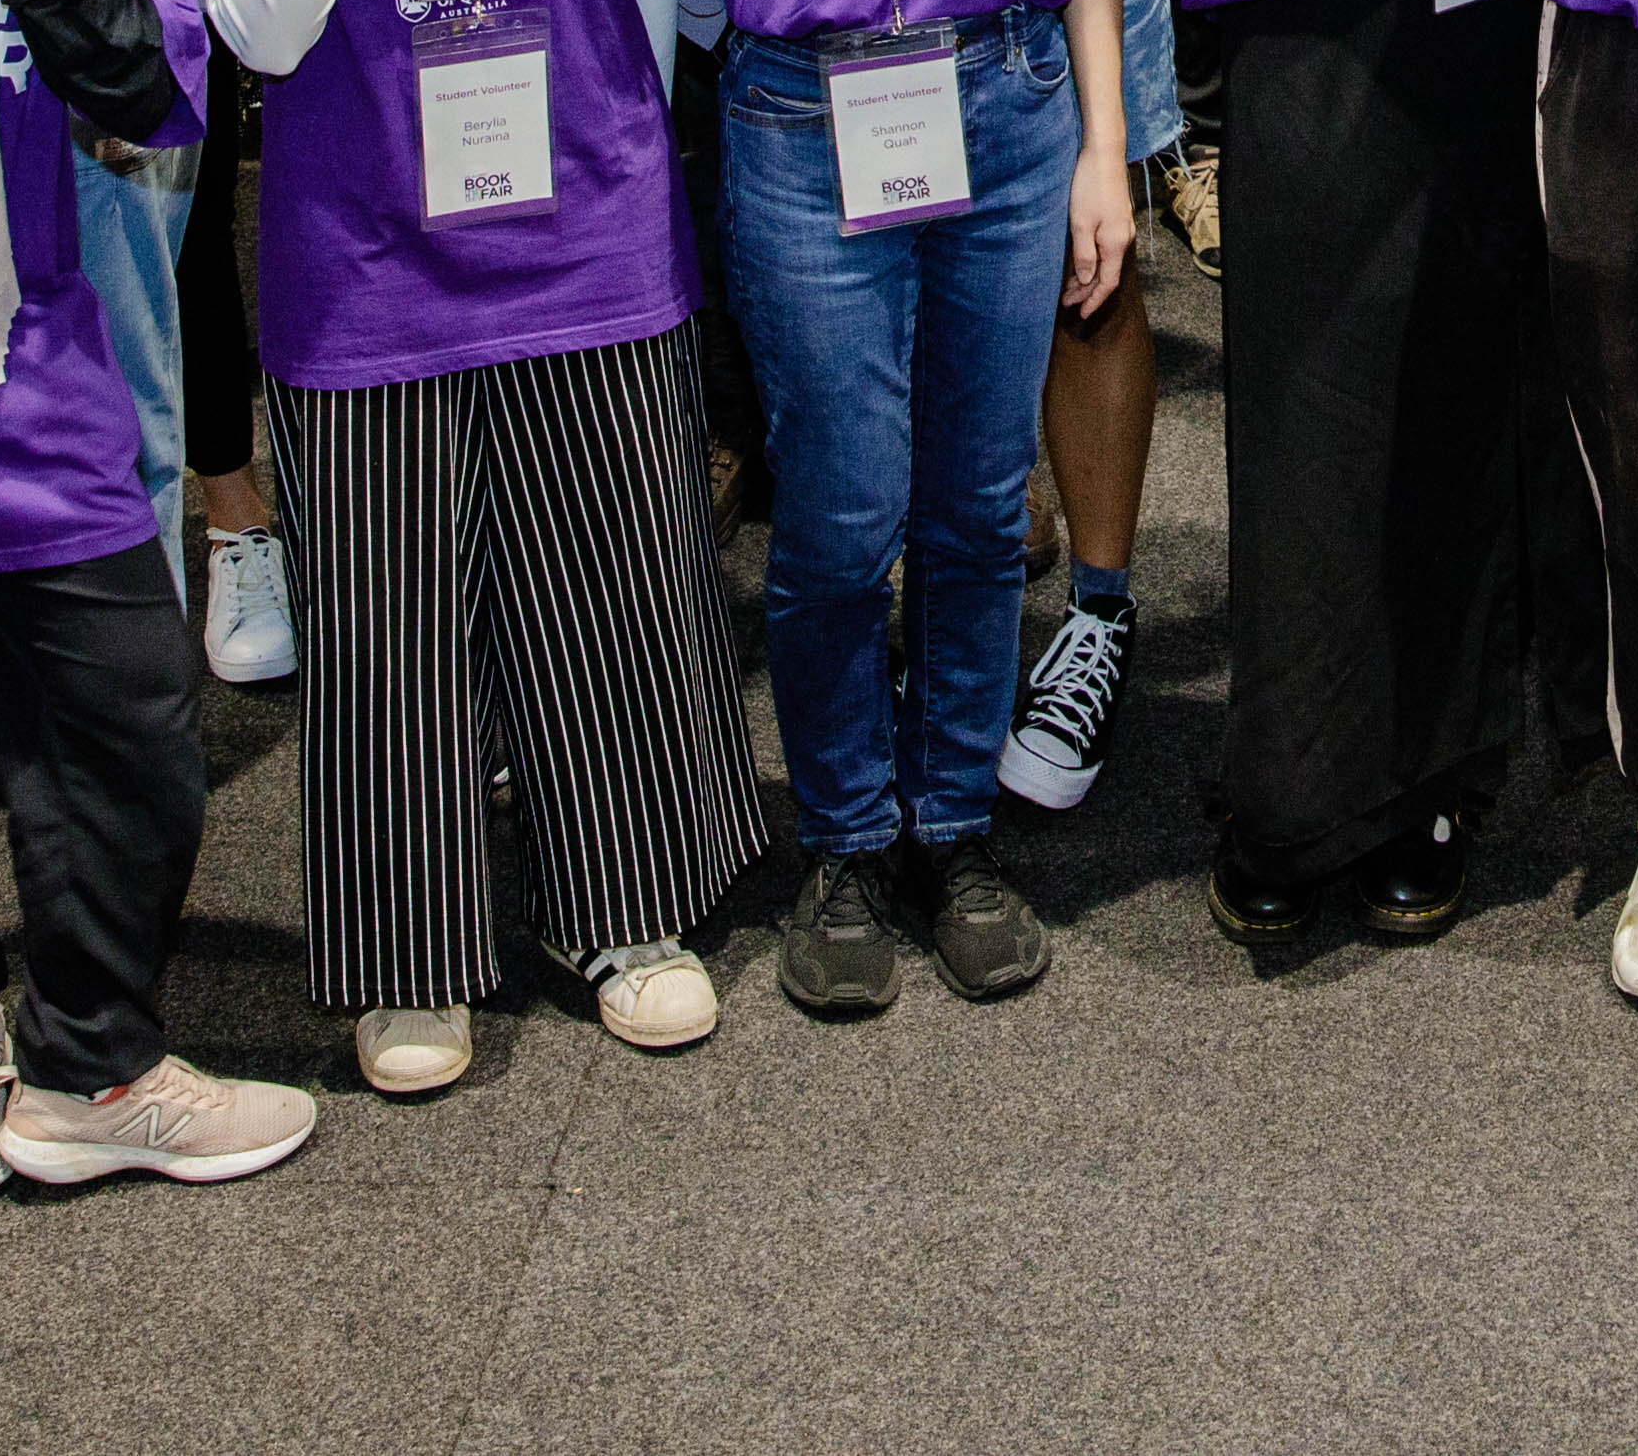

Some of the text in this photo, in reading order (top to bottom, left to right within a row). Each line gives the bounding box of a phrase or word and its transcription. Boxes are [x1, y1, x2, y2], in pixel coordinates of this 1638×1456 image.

[435, 81, 532, 103] Student Volunteer
[847, 86, 943, 108] Student Volunteer
[871, 120, 927, 137] Shannon
[462, 131, 511, 148] Nuraina
[883, 136, 918, 149] Quah
[464, 172, 511, 190] BOOK
[881, 174, 930, 194] BOOK
[481, 185, 513, 200] FAIR
[898, 187, 931, 202] FAIR
